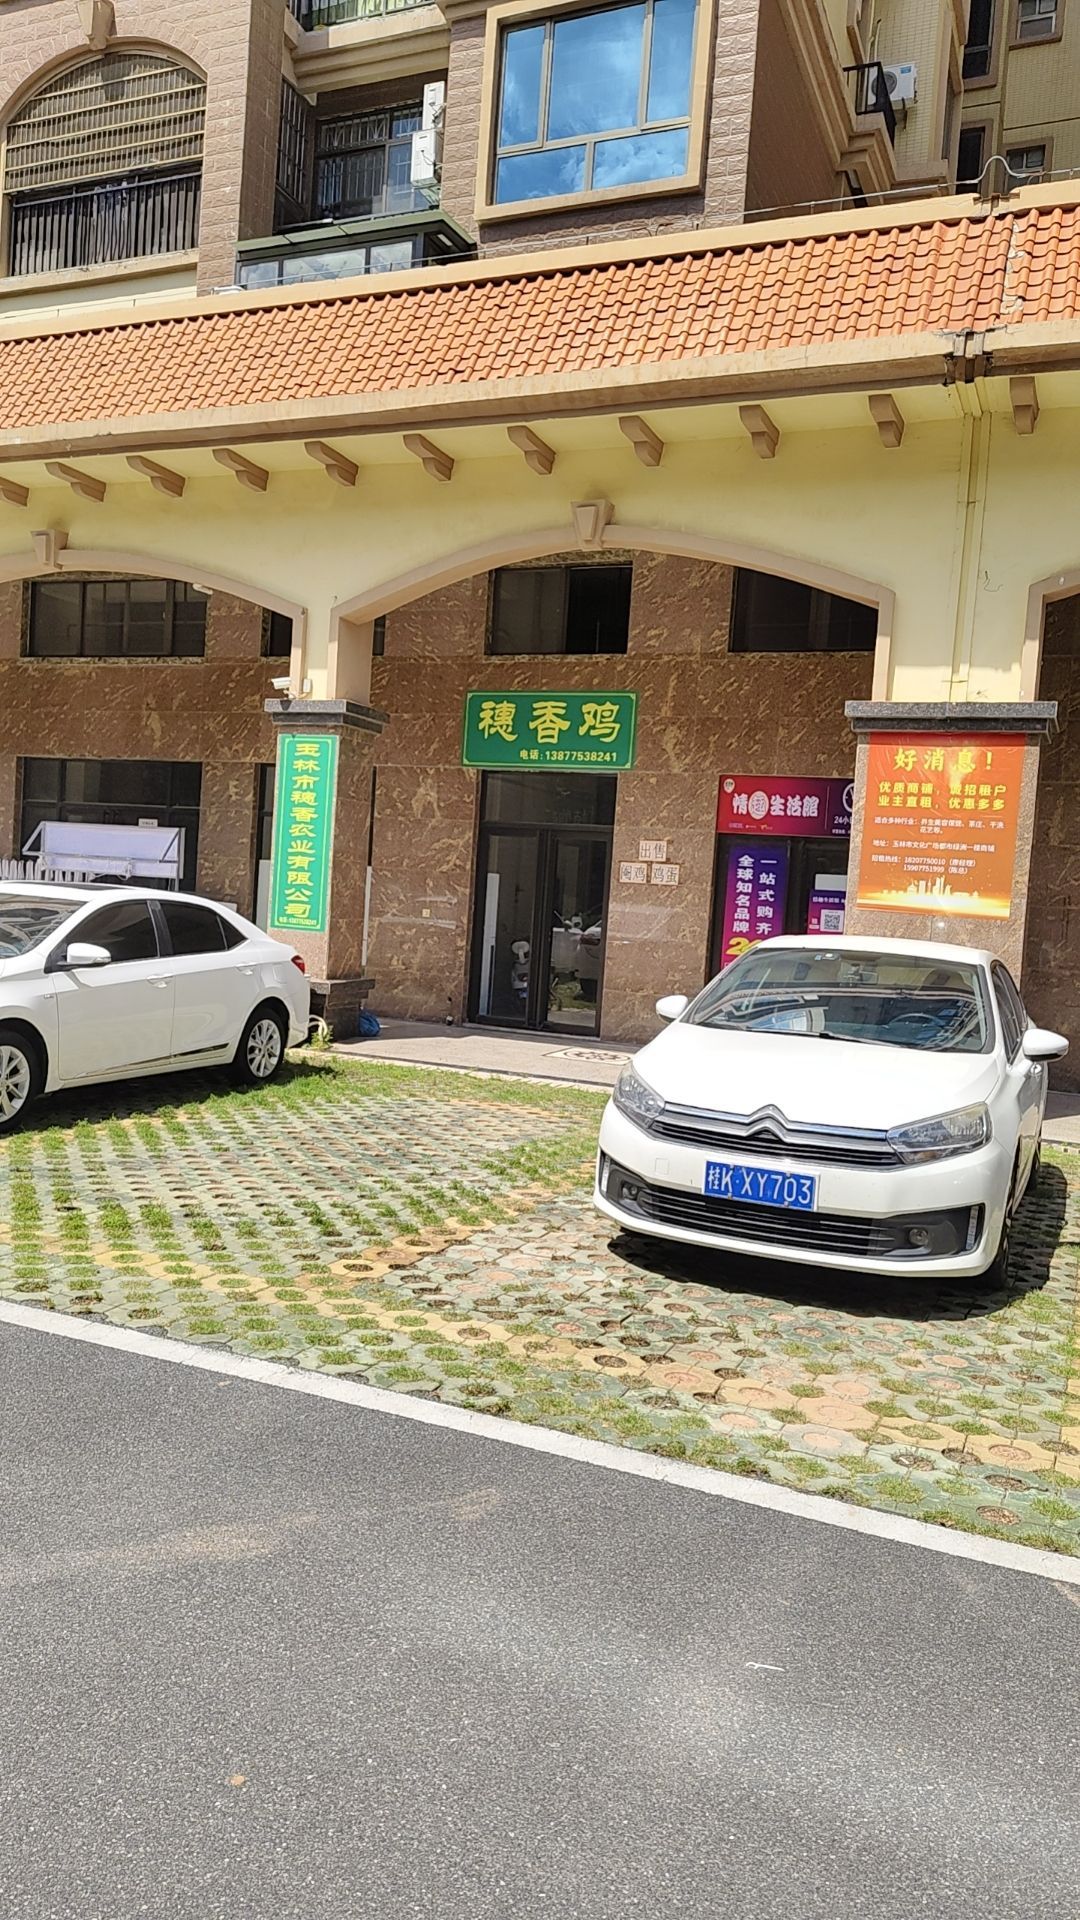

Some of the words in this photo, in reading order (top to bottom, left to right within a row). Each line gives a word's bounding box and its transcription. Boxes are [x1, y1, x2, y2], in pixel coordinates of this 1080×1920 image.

[478, 700, 621, 744] 穗香鸡
[284, 743, 321, 918] 玉林市穗香农业有限公司
[640, 842, 666, 859] 出售
[732, 854, 755, 933] 全球知名品牌
[755, 859, 777, 935] 一站式购齐
